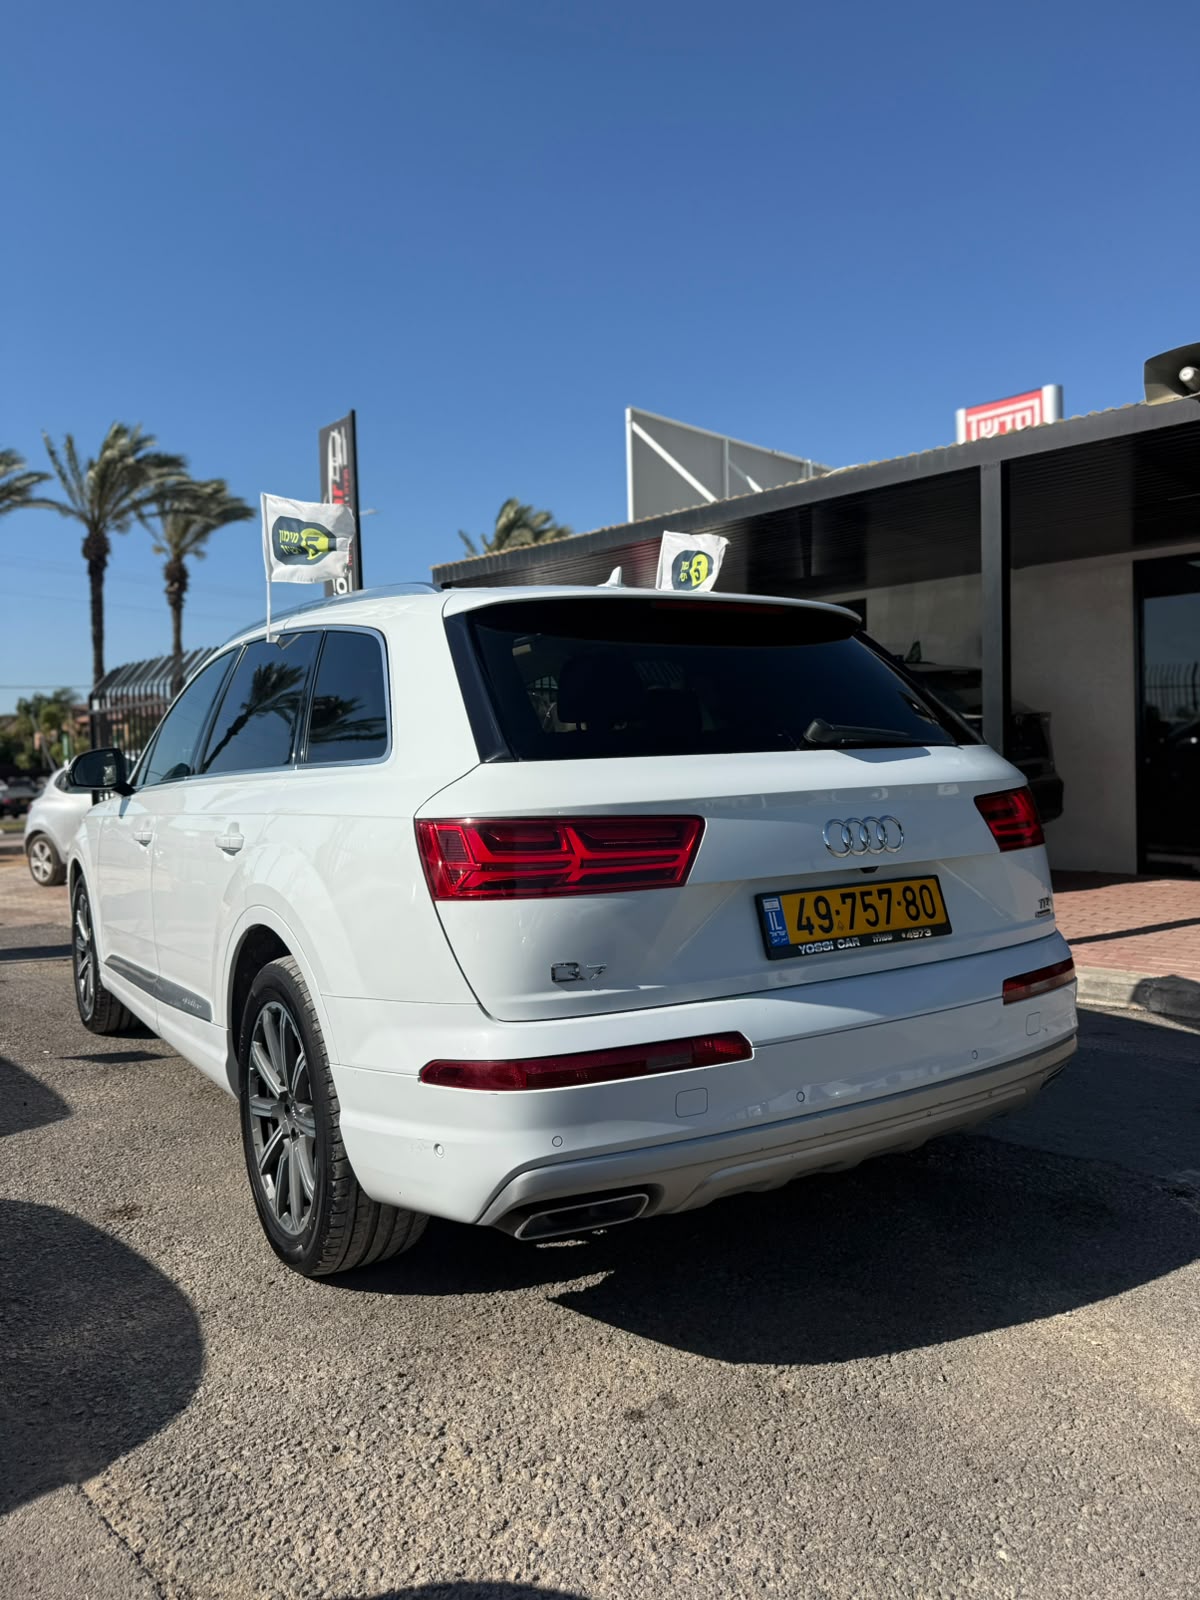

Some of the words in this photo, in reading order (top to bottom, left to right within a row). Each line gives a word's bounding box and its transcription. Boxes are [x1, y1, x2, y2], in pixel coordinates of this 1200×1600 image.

[768, 911, 783, 931] IL
[798, 940, 835, 955] YOSSI
[836, 937, 861, 949] CAR
[551, 962, 607, 983] Q7
